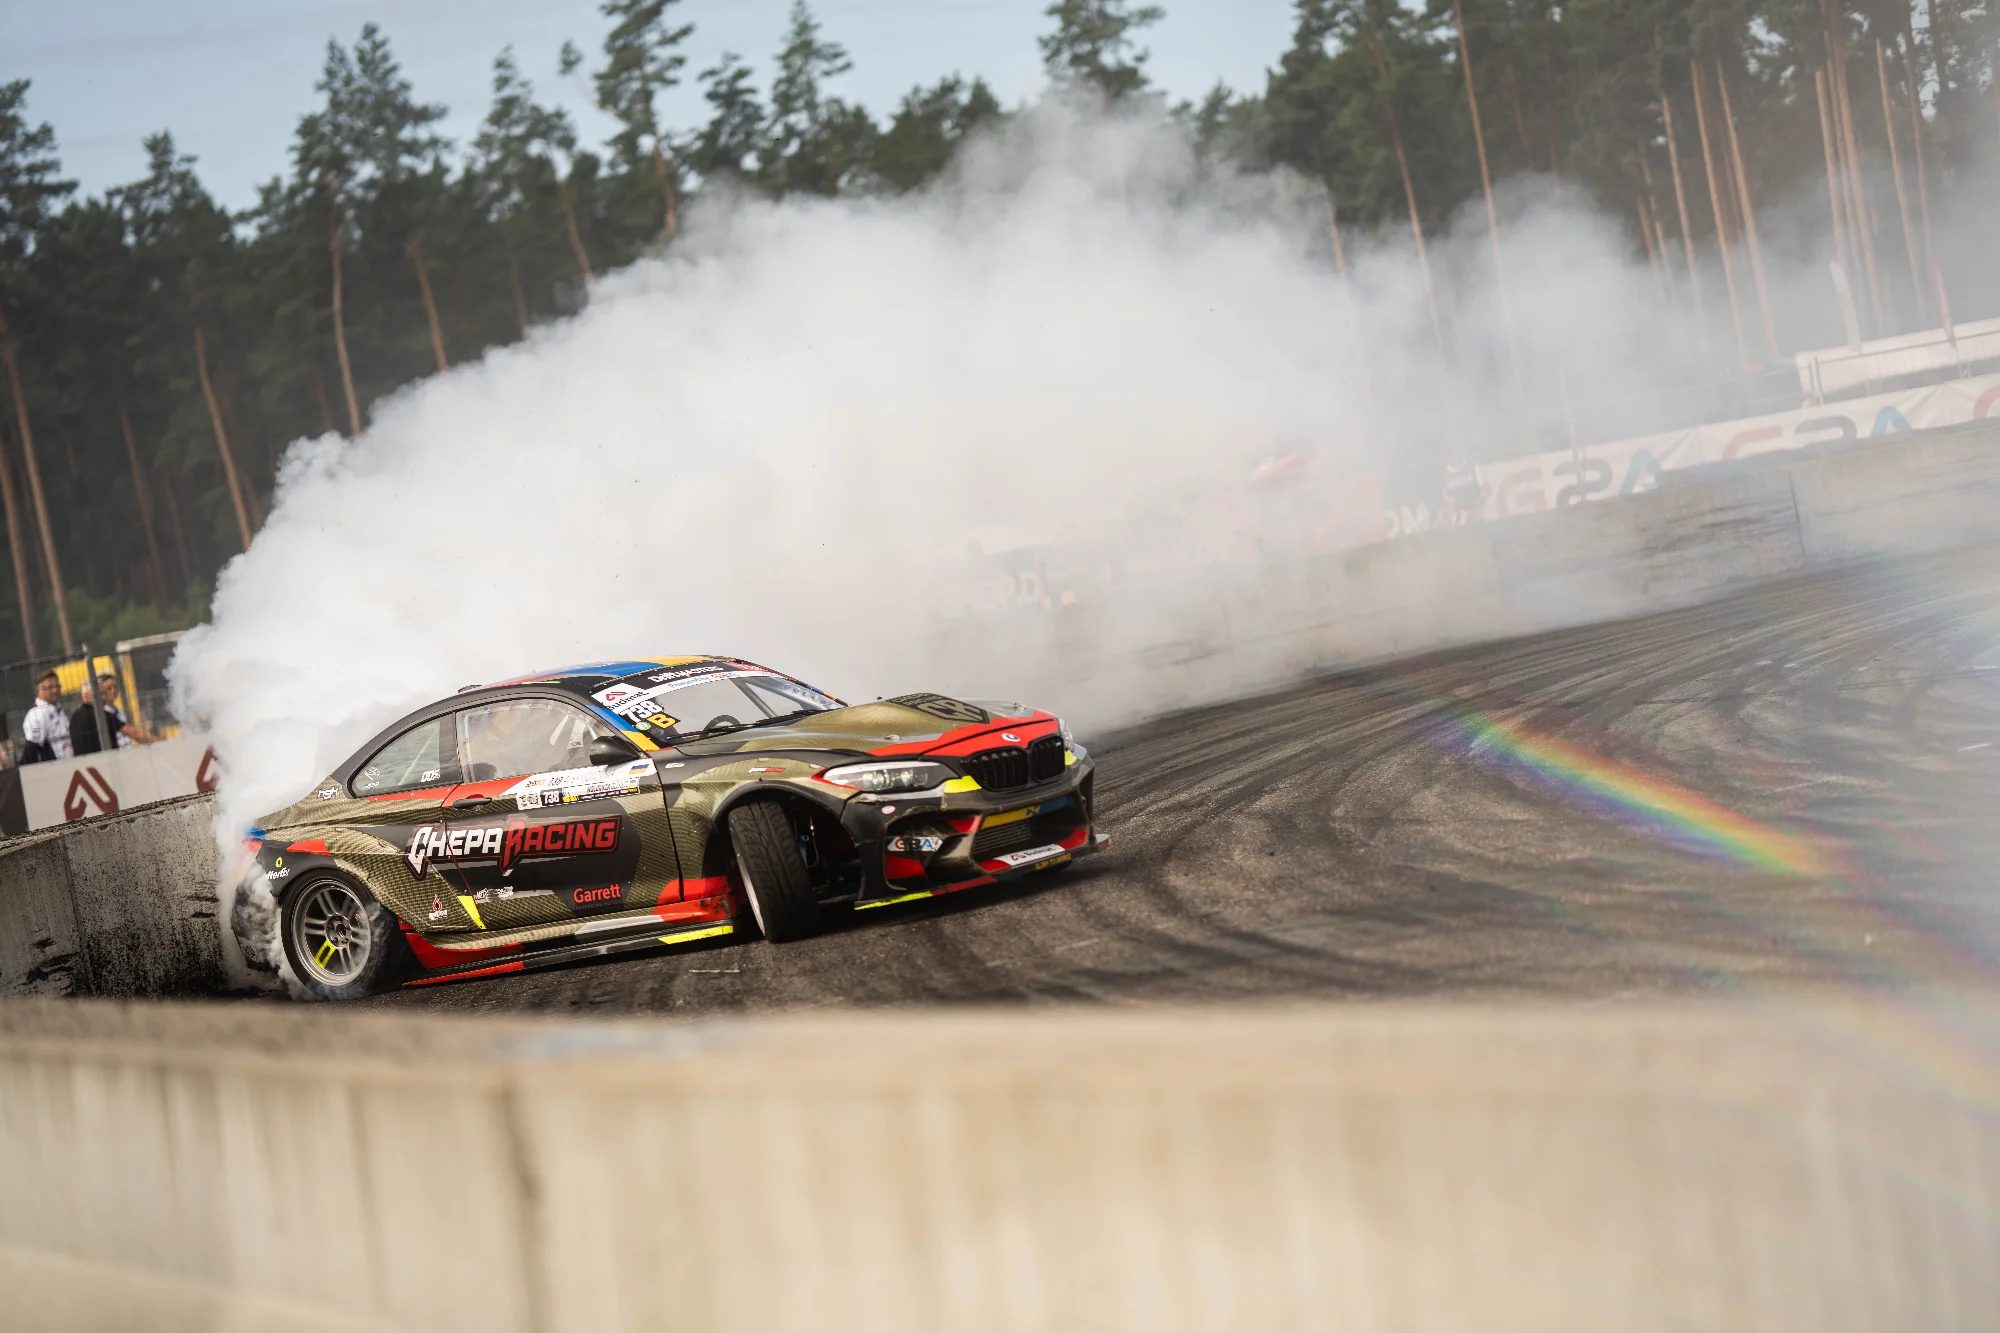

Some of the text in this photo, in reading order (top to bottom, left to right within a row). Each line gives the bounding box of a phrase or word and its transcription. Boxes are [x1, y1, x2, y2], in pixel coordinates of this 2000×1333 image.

[619, 699, 663, 723] 738
[647, 713, 677, 729] B
[542, 790, 560, 805] 738
[409, 821, 616, 874] CHEPA RACING
[573, 884, 621, 903] Garrett
